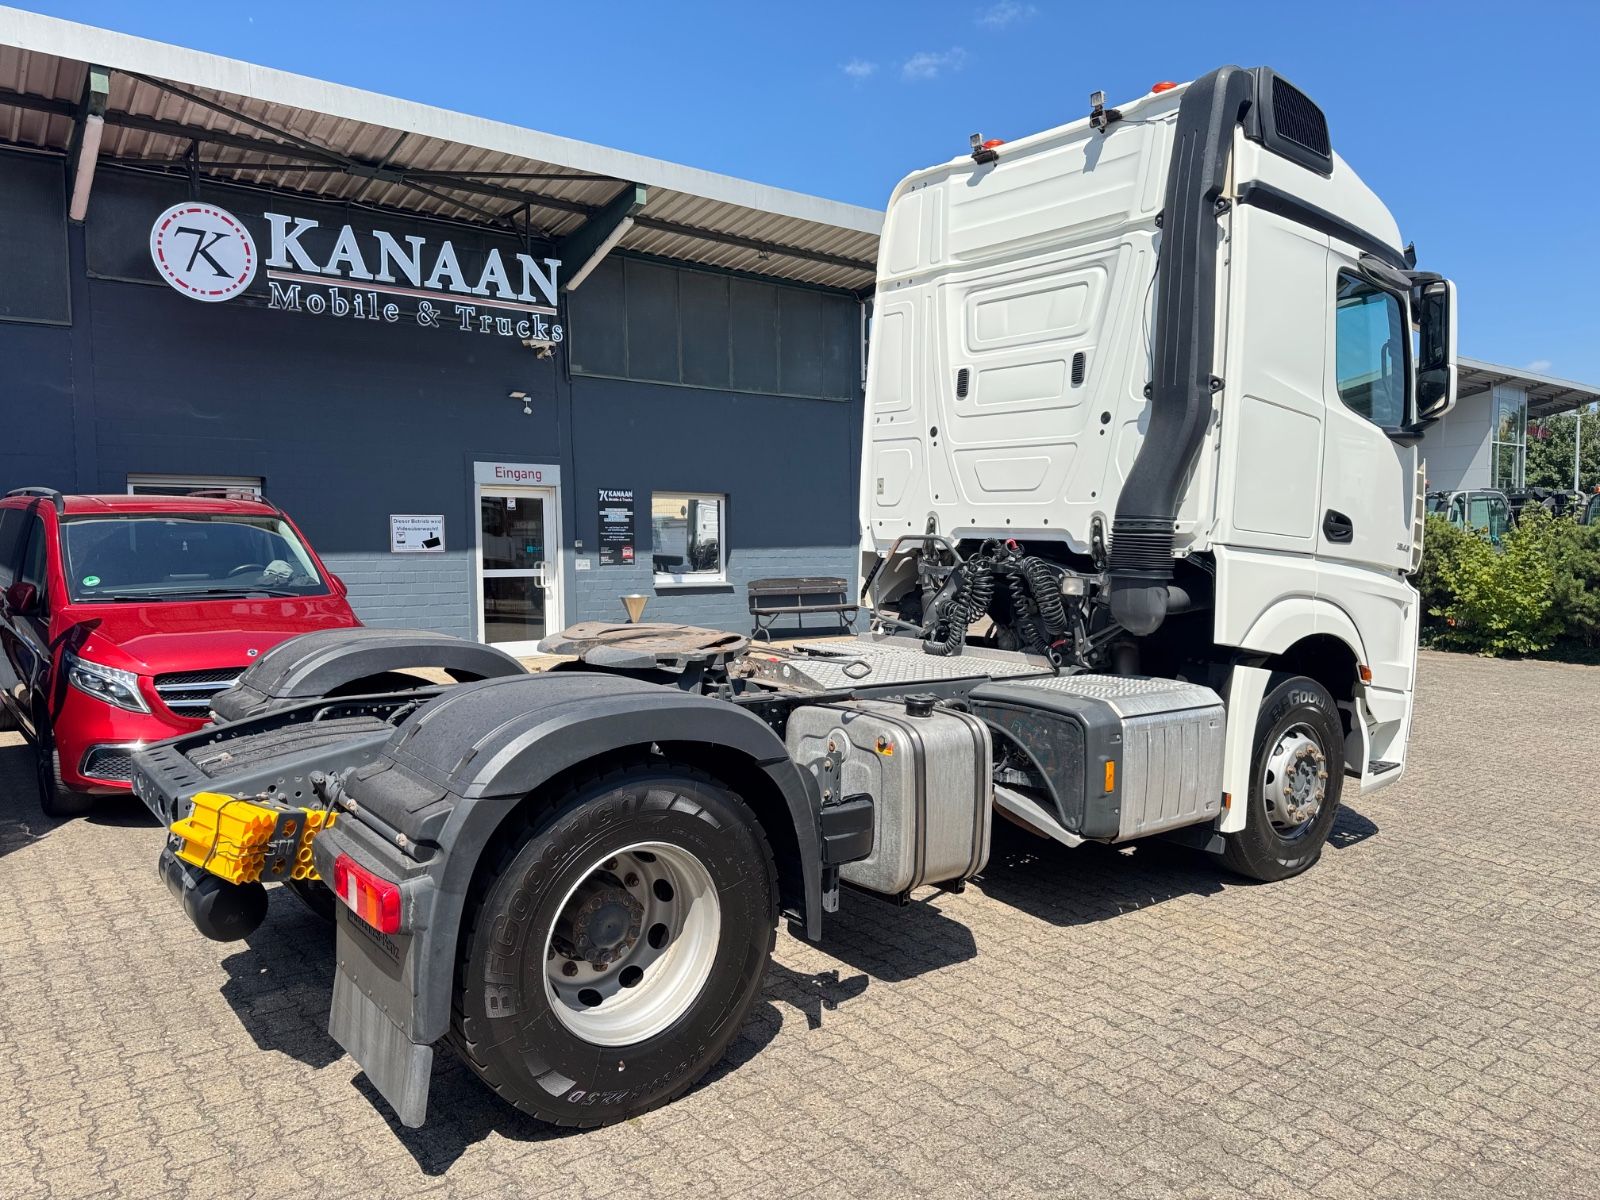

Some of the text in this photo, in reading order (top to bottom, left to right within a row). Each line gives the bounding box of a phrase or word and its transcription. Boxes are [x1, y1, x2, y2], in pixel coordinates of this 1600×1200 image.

[264, 212, 562, 306] KANAAN
[268, 282, 564, 343] Mobile & Trucks
[495, 466, 542, 482] Eingang
[485, 788, 637, 1018] BFGoodrich
